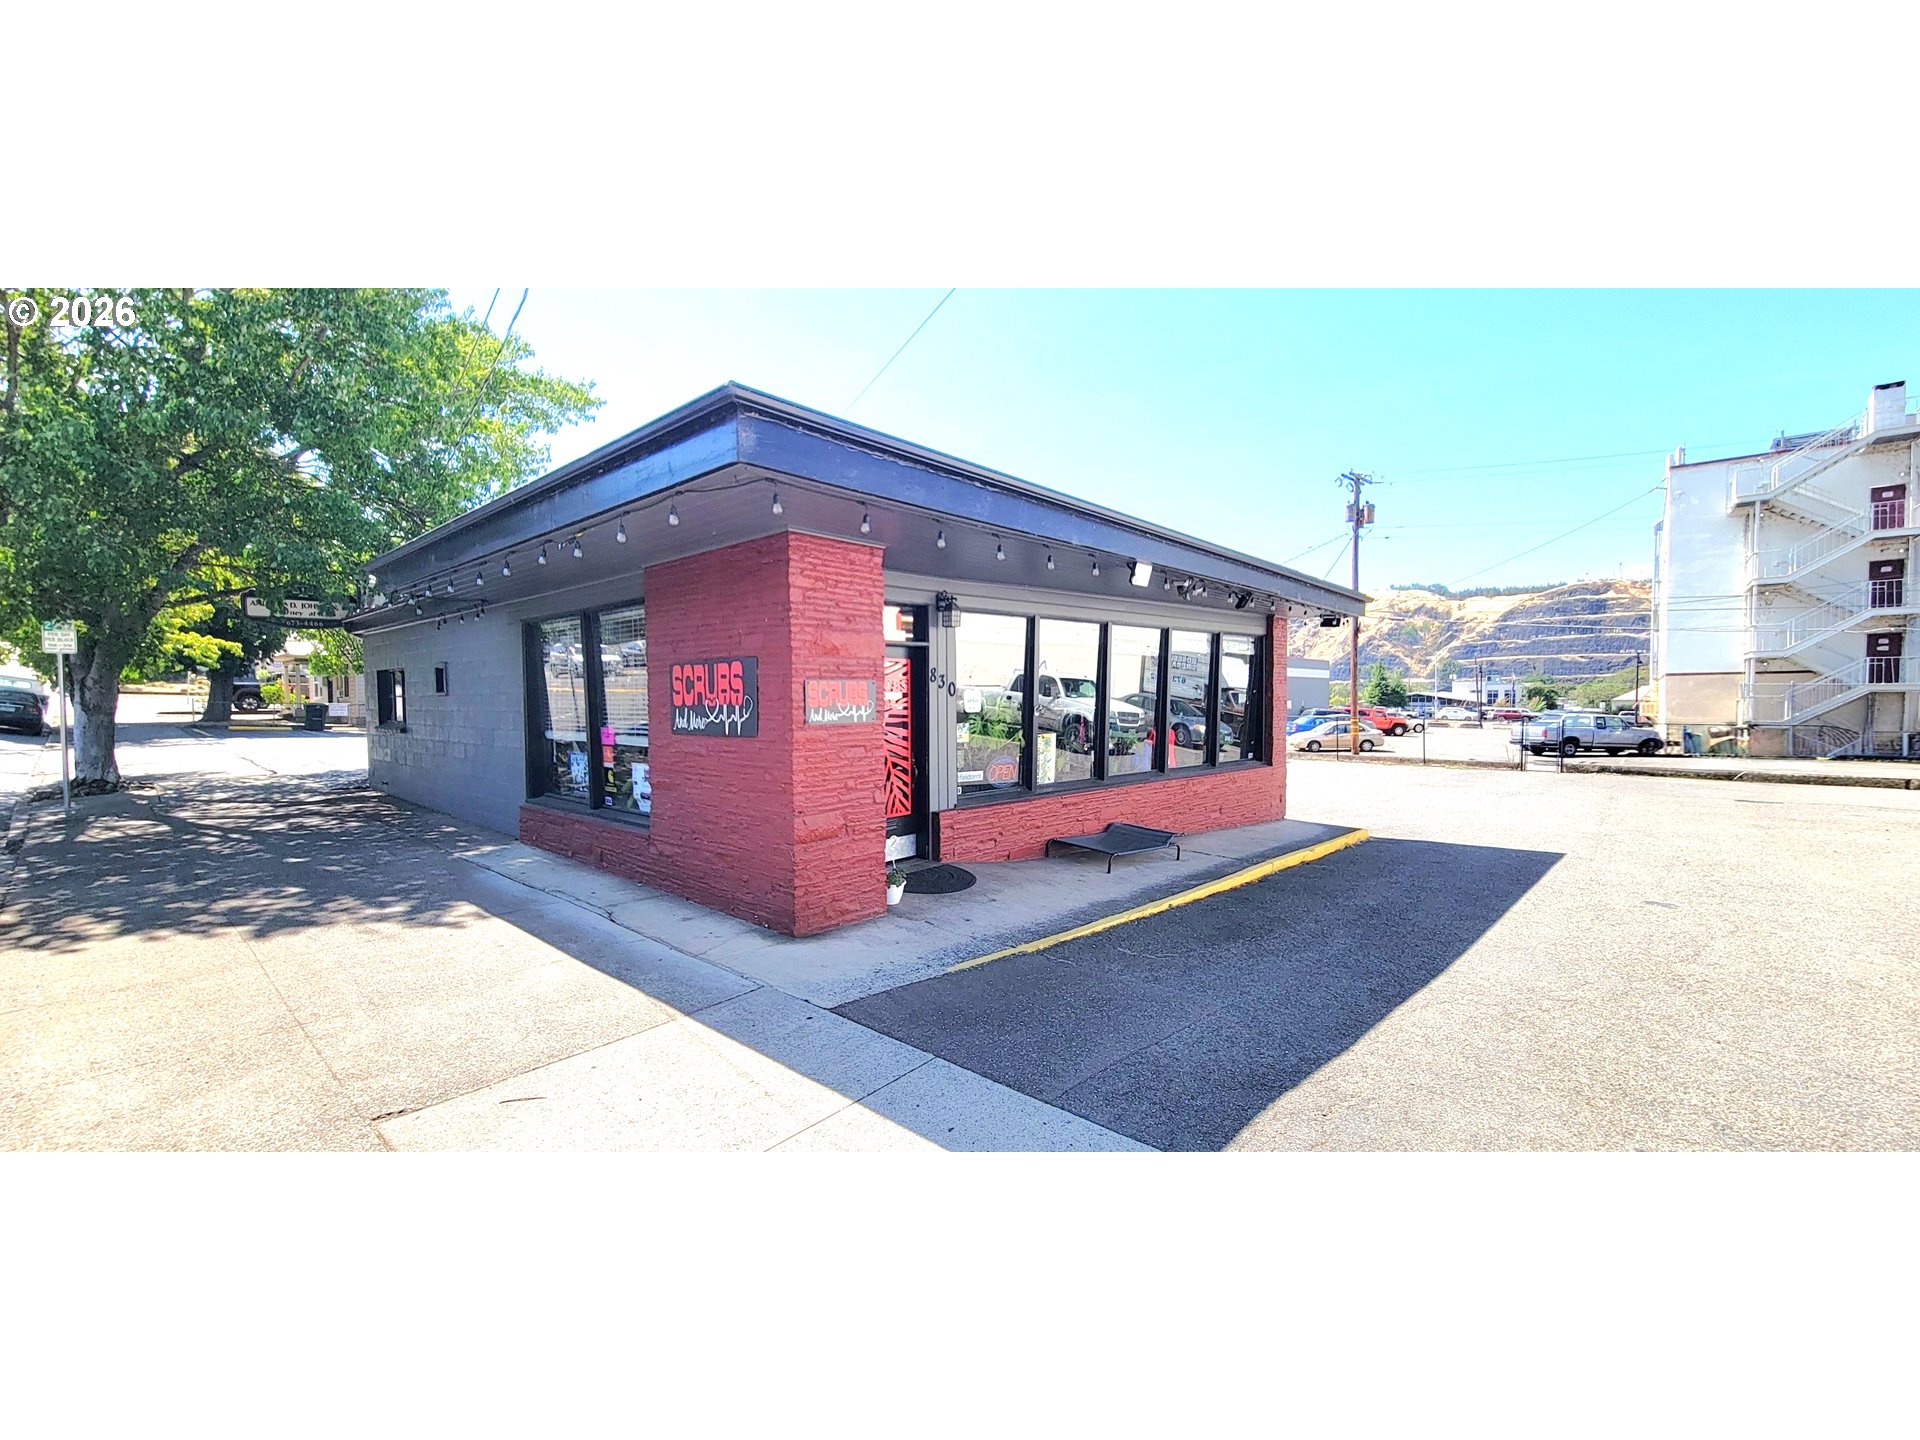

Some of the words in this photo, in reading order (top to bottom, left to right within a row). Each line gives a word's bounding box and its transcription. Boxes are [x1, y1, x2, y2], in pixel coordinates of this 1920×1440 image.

[672, 661, 743, 707] SCRUBS
[808, 680, 868, 708] SCRUBS
[930, 667, 956, 697] 830
[989, 764, 1017, 781] OPEN
